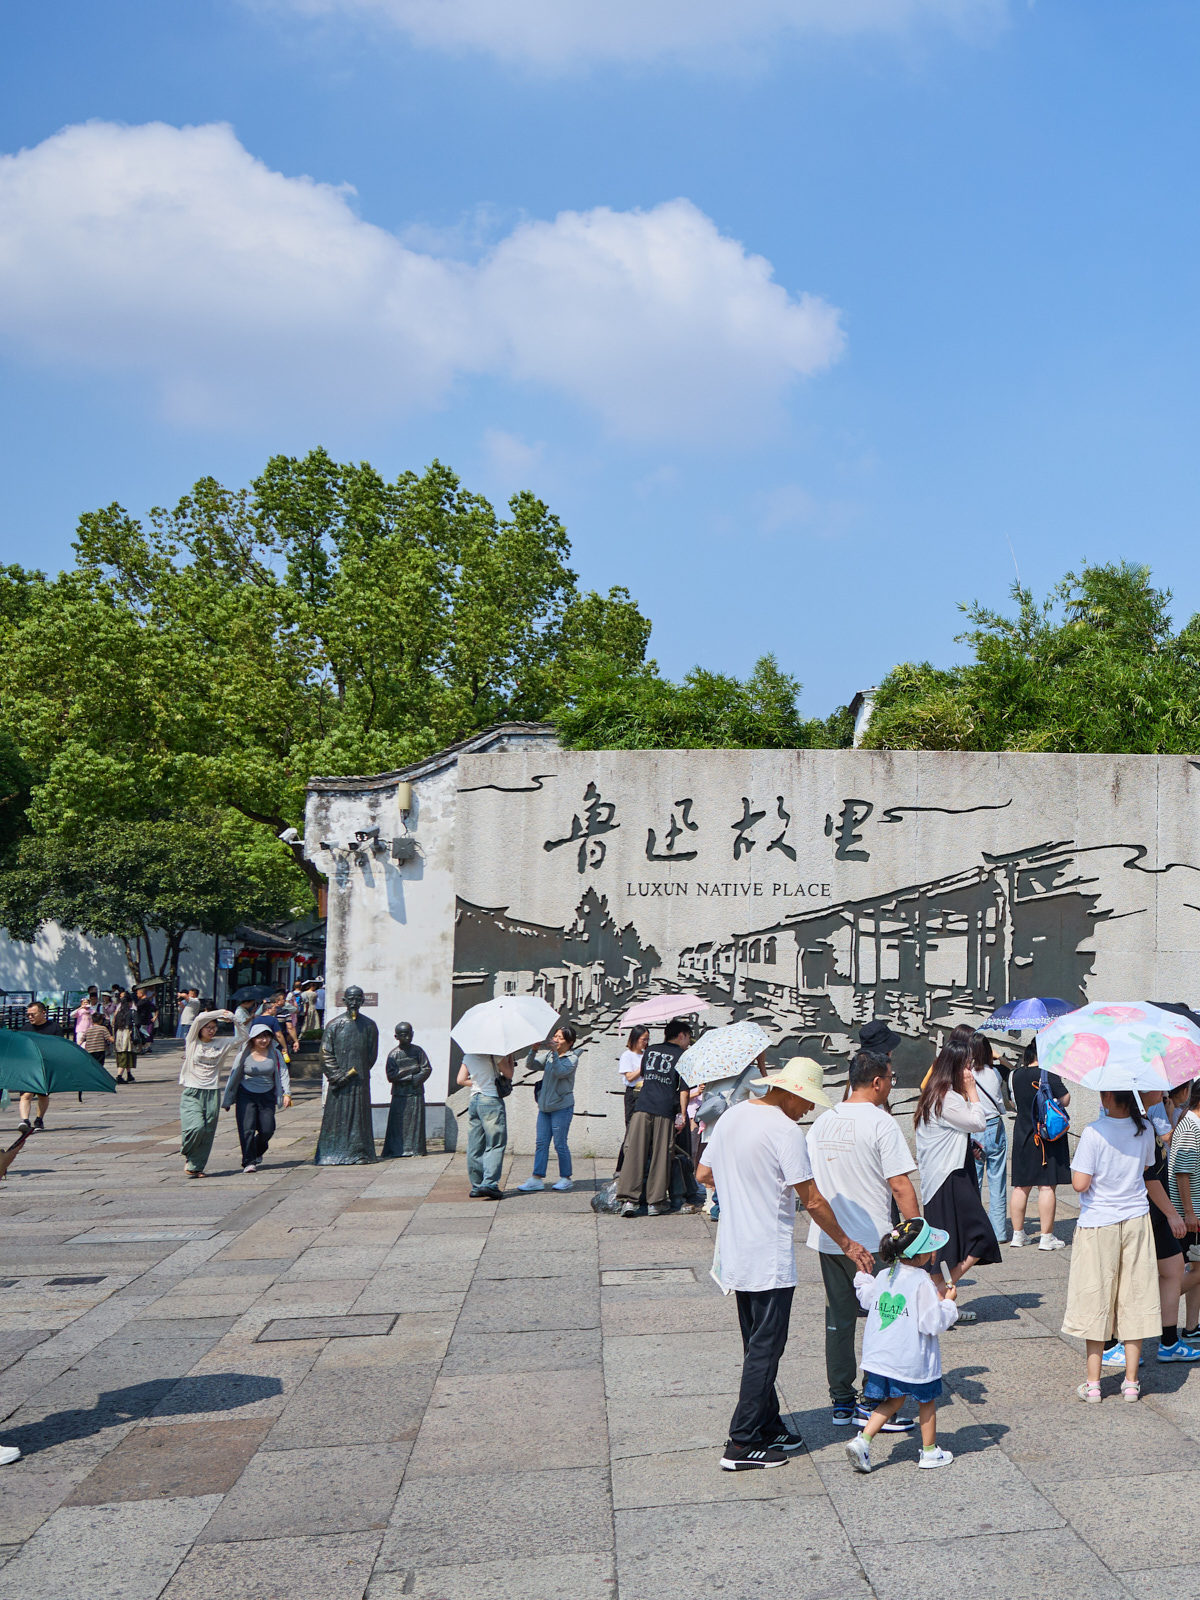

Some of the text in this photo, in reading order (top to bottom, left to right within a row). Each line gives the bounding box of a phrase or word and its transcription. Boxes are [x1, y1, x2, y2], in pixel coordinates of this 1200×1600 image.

[543, 781, 874, 874] 鲁迅故里
[627, 882, 832, 897] LUXUN NATIVE PLACE
[874, 1300, 909, 1317] LALALA
